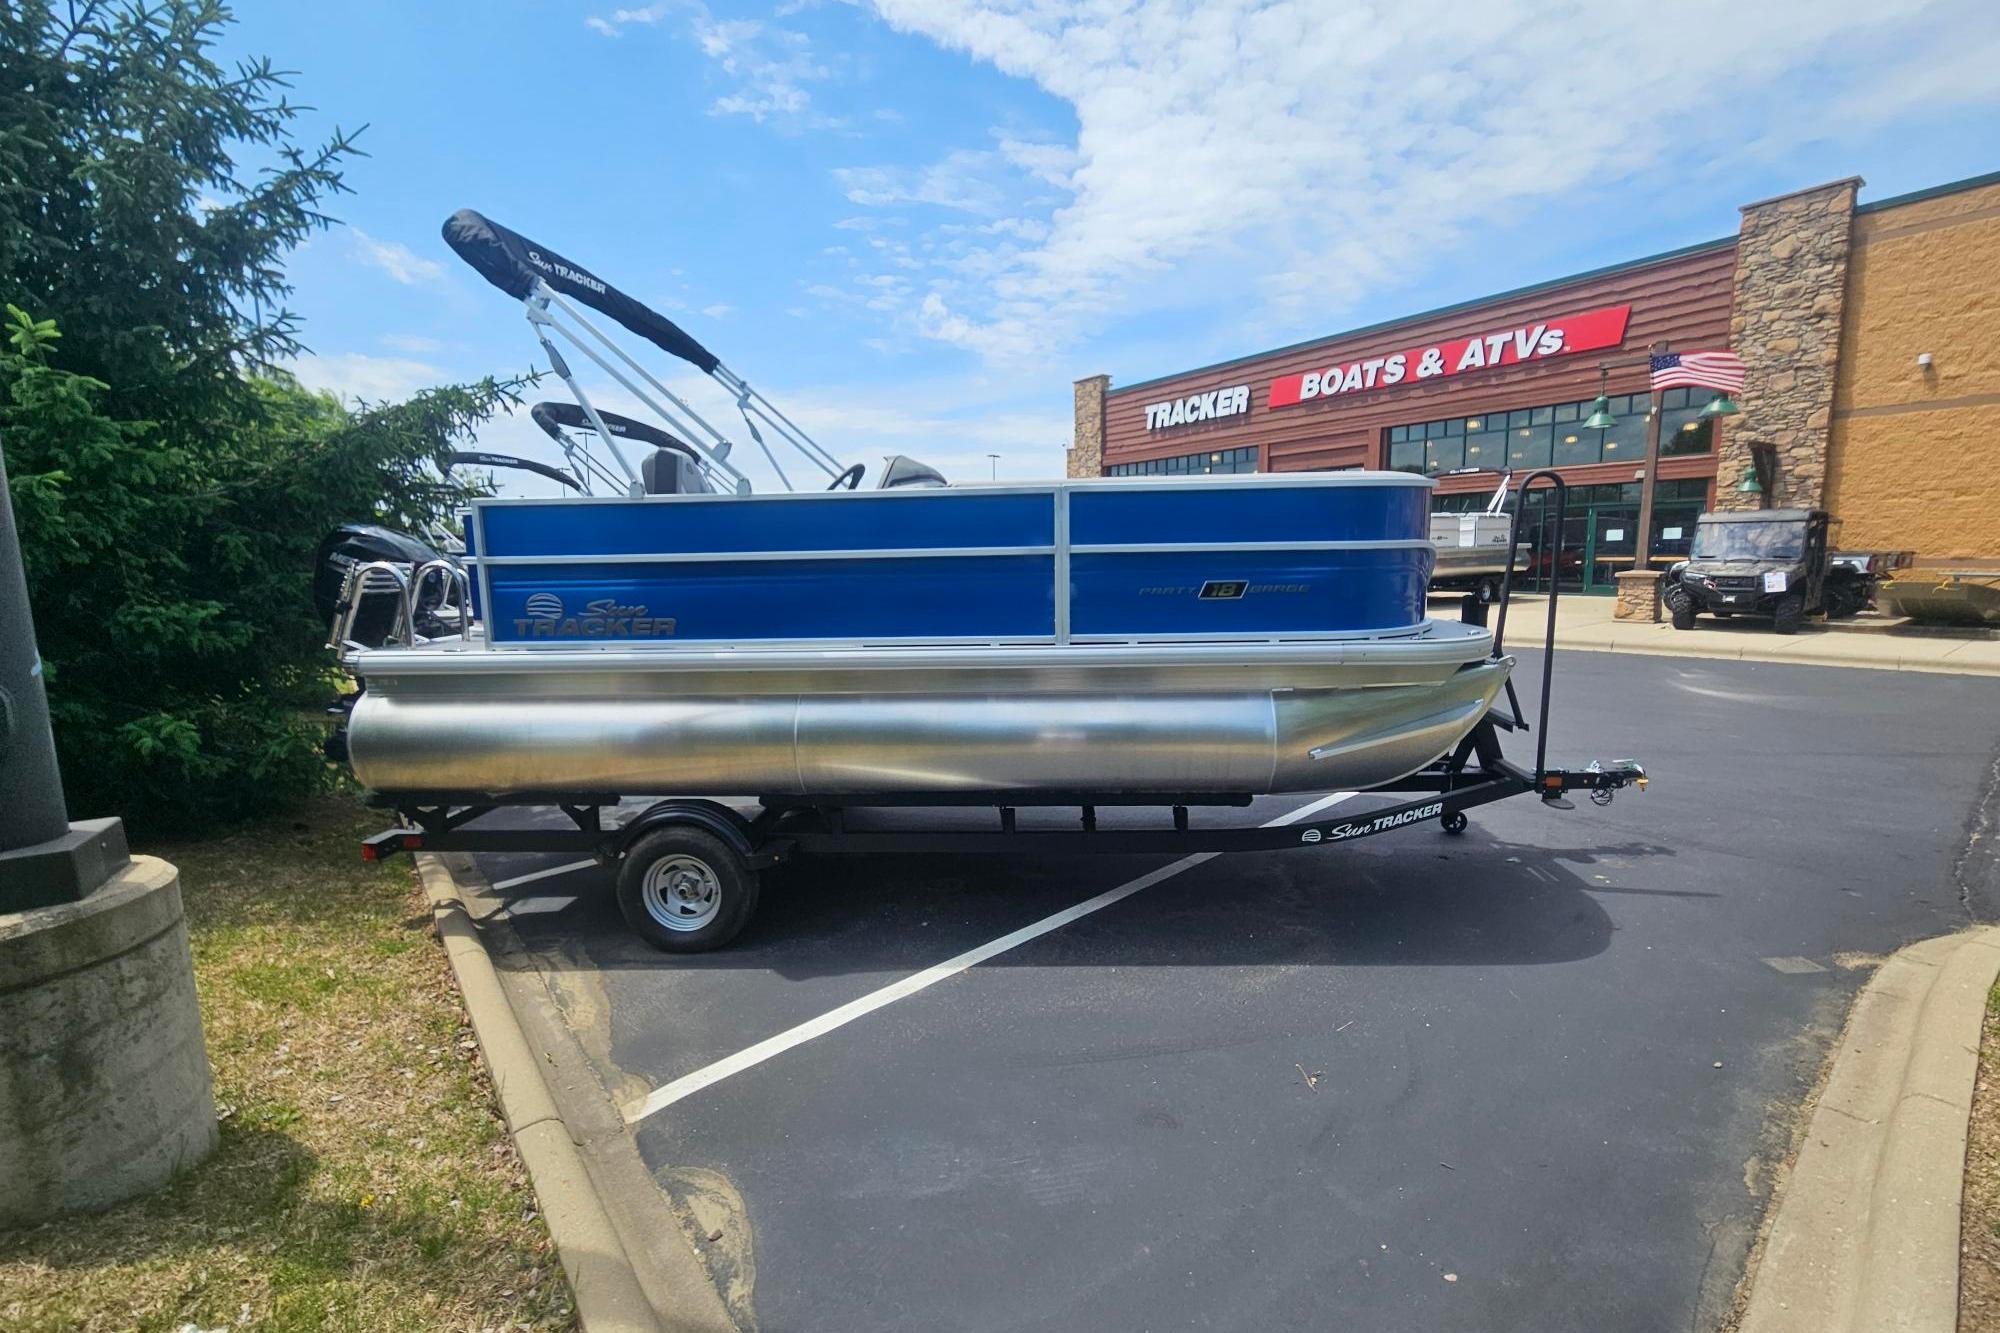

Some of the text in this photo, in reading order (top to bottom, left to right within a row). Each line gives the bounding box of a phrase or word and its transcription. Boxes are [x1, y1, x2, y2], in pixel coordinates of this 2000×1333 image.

[529, 251, 606, 294] Sun TRACKER
[1300, 325, 1564, 400] BOATS & ATVs
[1145, 385, 1250, 430] TRACKER
[578, 599, 649, 617] Sun
[1138, 584, 1311, 597] PARTY 18 BARGE
[513, 618, 677, 636] TRACKER
[1327, 802, 1443, 840] Sun TRACKER
